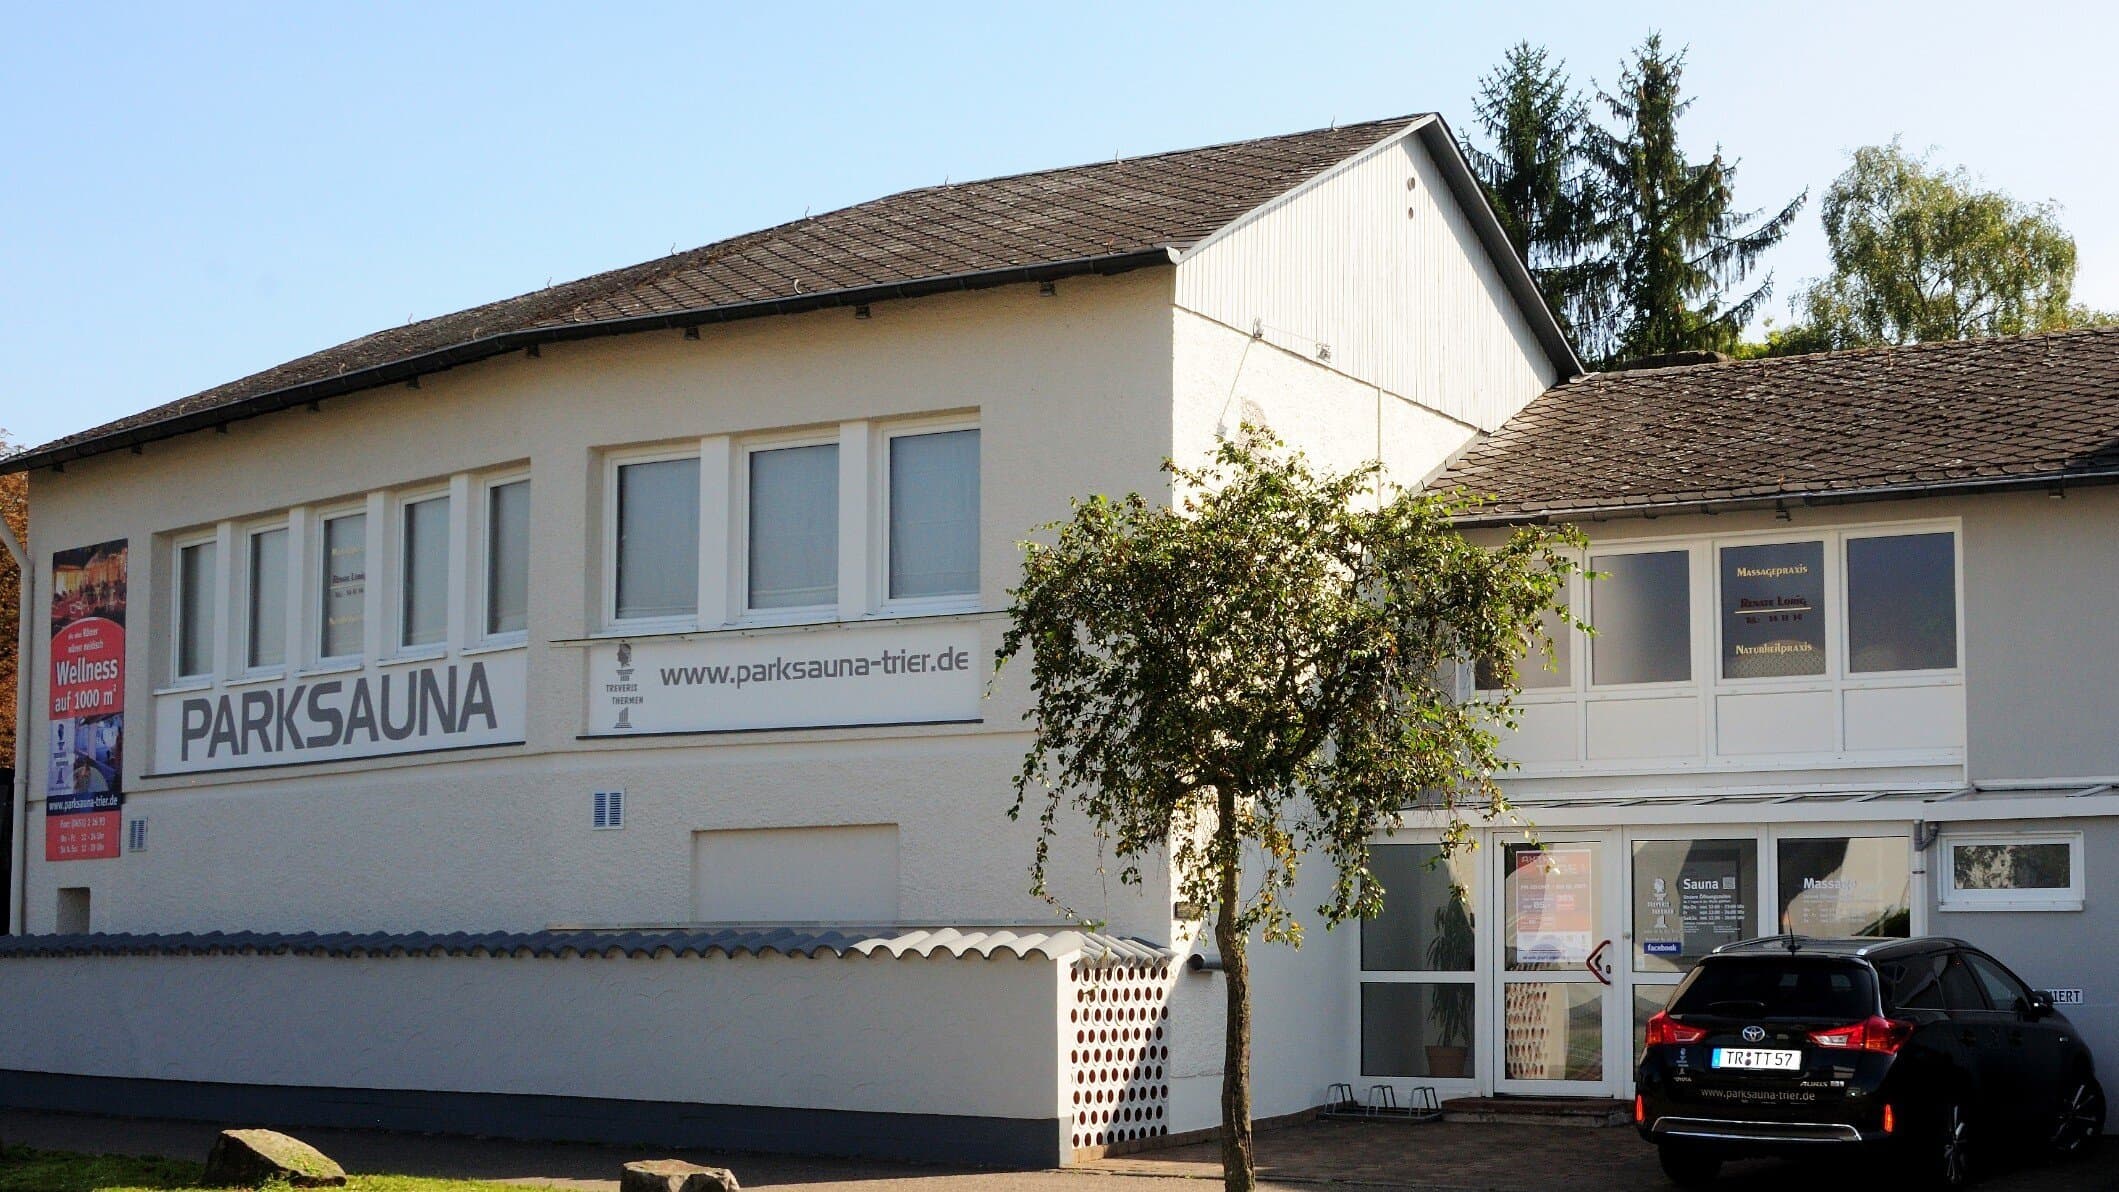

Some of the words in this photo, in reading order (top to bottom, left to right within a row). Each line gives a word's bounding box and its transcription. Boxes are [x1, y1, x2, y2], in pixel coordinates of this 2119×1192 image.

[56, 656, 119, 686] Wellness
[660, 646, 969, 689] www.parksauna-trier.de
[55, 691, 71, 712] auf
[74, 688, 100, 709] 1000
[181, 662, 498, 761] PARKSAUNA
[1683, 878, 1719, 890] Sauna
[1647, 944, 1677, 952] facebook
[2051, 990, 2080, 1002] IERT
[1727, 1051, 1743, 1065] TR
[1754, 1052, 1772, 1065] TT
[1775, 1052, 1793, 1067] 57
[1701, 1088, 1816, 1101] www.parksauna-trier.de
